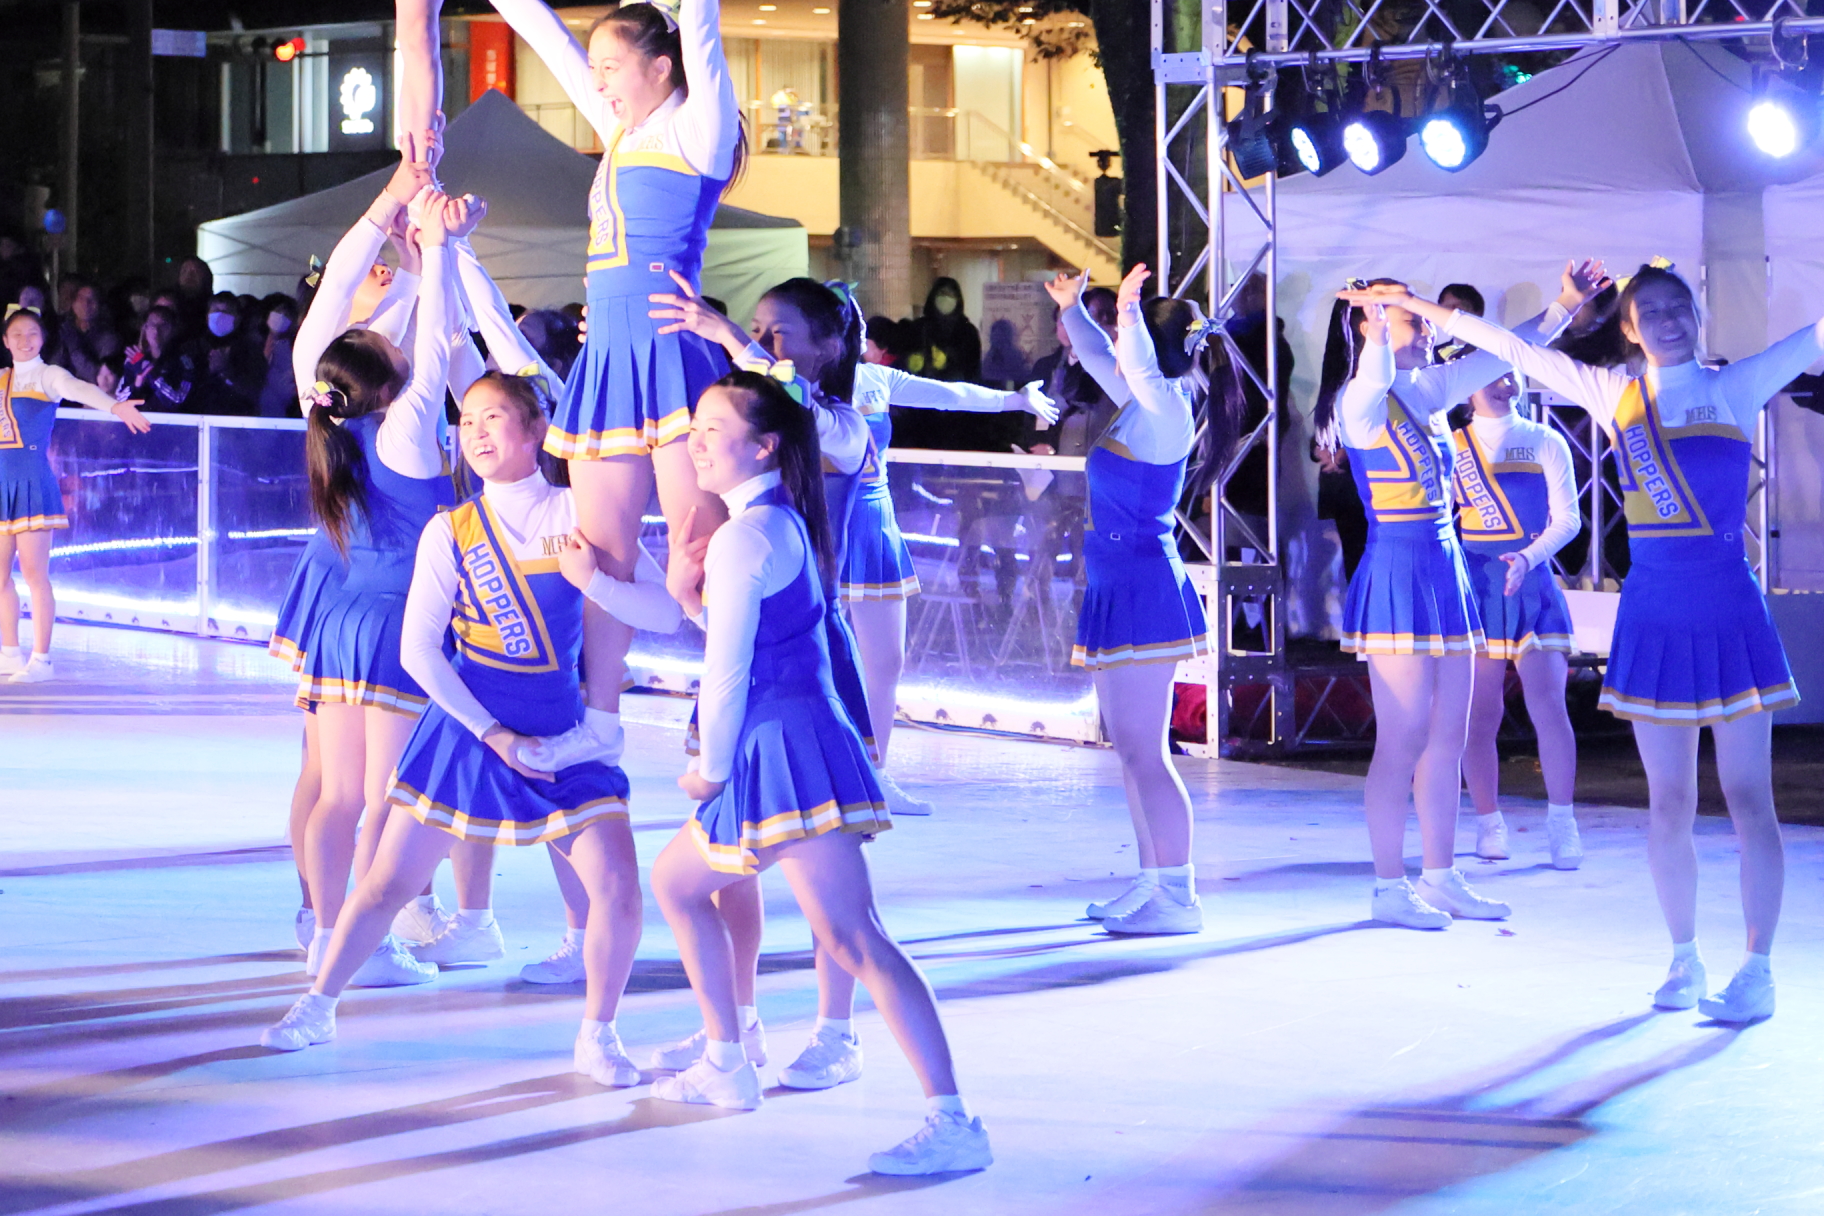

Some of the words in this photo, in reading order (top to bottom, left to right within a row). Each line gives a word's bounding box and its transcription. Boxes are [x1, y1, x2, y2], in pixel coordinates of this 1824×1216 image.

[1505, 447, 1535, 461] MHS
[1686, 406, 1717, 424] MHS
[1397, 421, 1438, 501] HOPPERS
[1456, 449, 1502, 530] HOPPERS
[1625, 424, 1680, 519] HOPPERS
[540, 534, 572, 556] MH
[467, 541, 532, 657] HOPPERS
